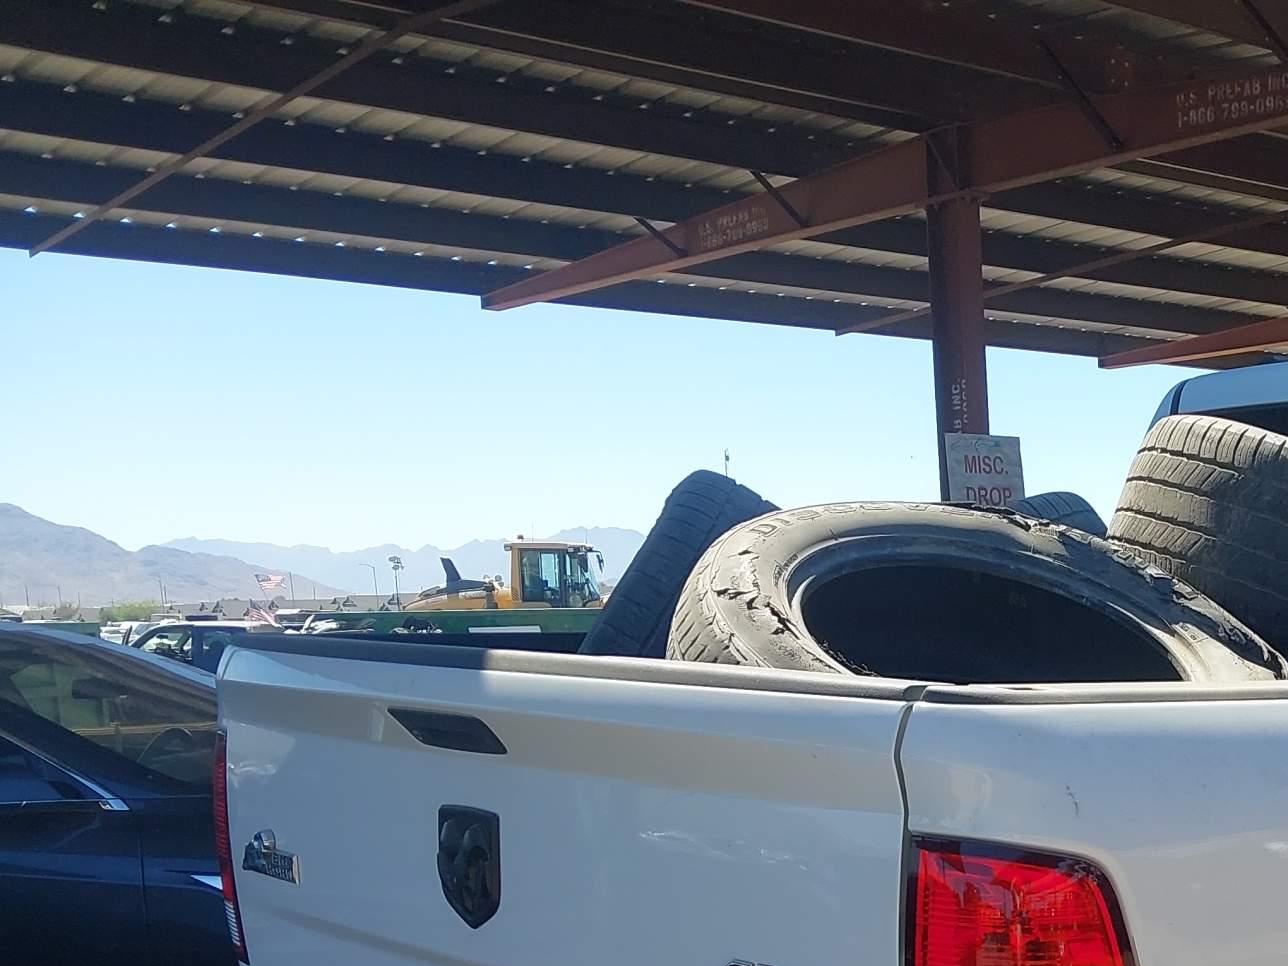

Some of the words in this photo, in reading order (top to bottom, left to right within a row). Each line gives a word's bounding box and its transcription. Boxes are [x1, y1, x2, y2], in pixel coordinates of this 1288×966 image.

[1207, 79, 1261, 102] PREFAB
[963, 454, 1009, 475] MISC.
[964, 486, 1012, 506] DROP
